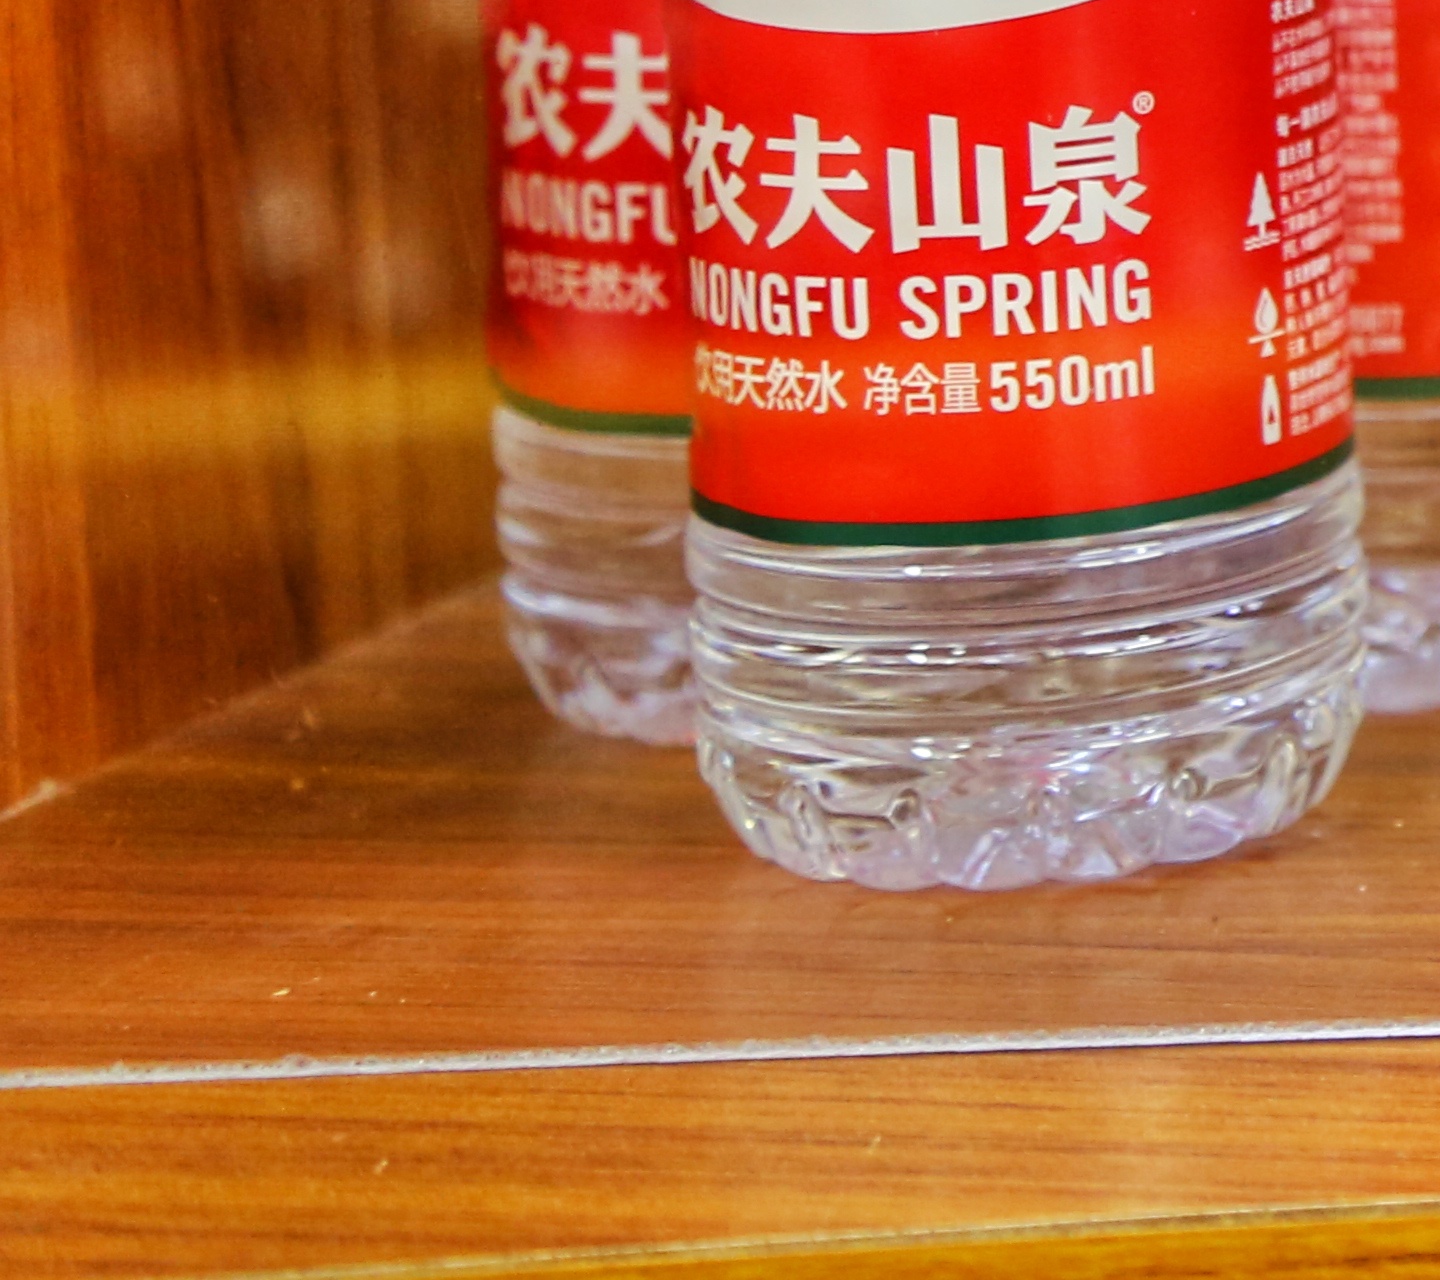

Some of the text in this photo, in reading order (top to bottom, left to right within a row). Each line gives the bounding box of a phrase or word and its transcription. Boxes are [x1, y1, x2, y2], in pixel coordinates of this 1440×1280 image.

[682, 104, 1152, 254] 农夫山泉
[689, 256, 1153, 341] NONGFU SPRING
[695, 344, 848, 415] 饮用天然水
